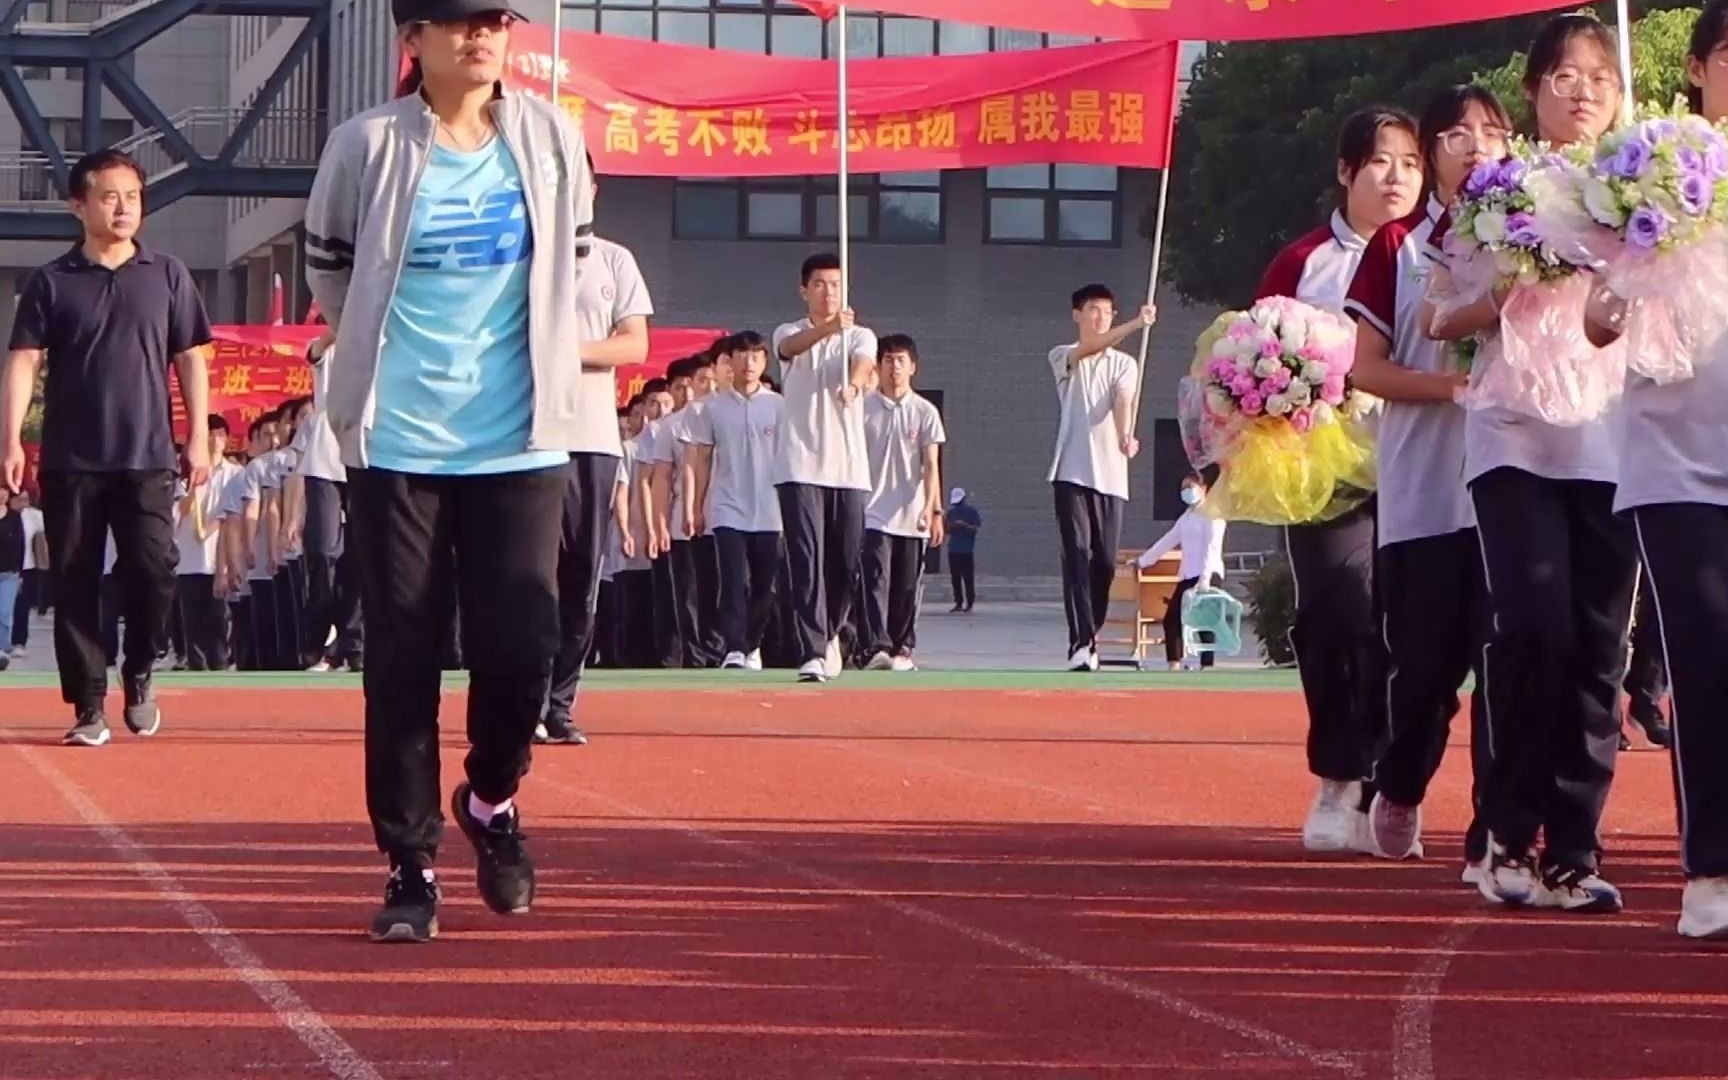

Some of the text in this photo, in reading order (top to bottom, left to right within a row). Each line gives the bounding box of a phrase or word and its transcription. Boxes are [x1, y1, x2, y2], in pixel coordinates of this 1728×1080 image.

[604, 103, 772, 157] 高考不败
[977, 90, 1144, 145] 属我最强
